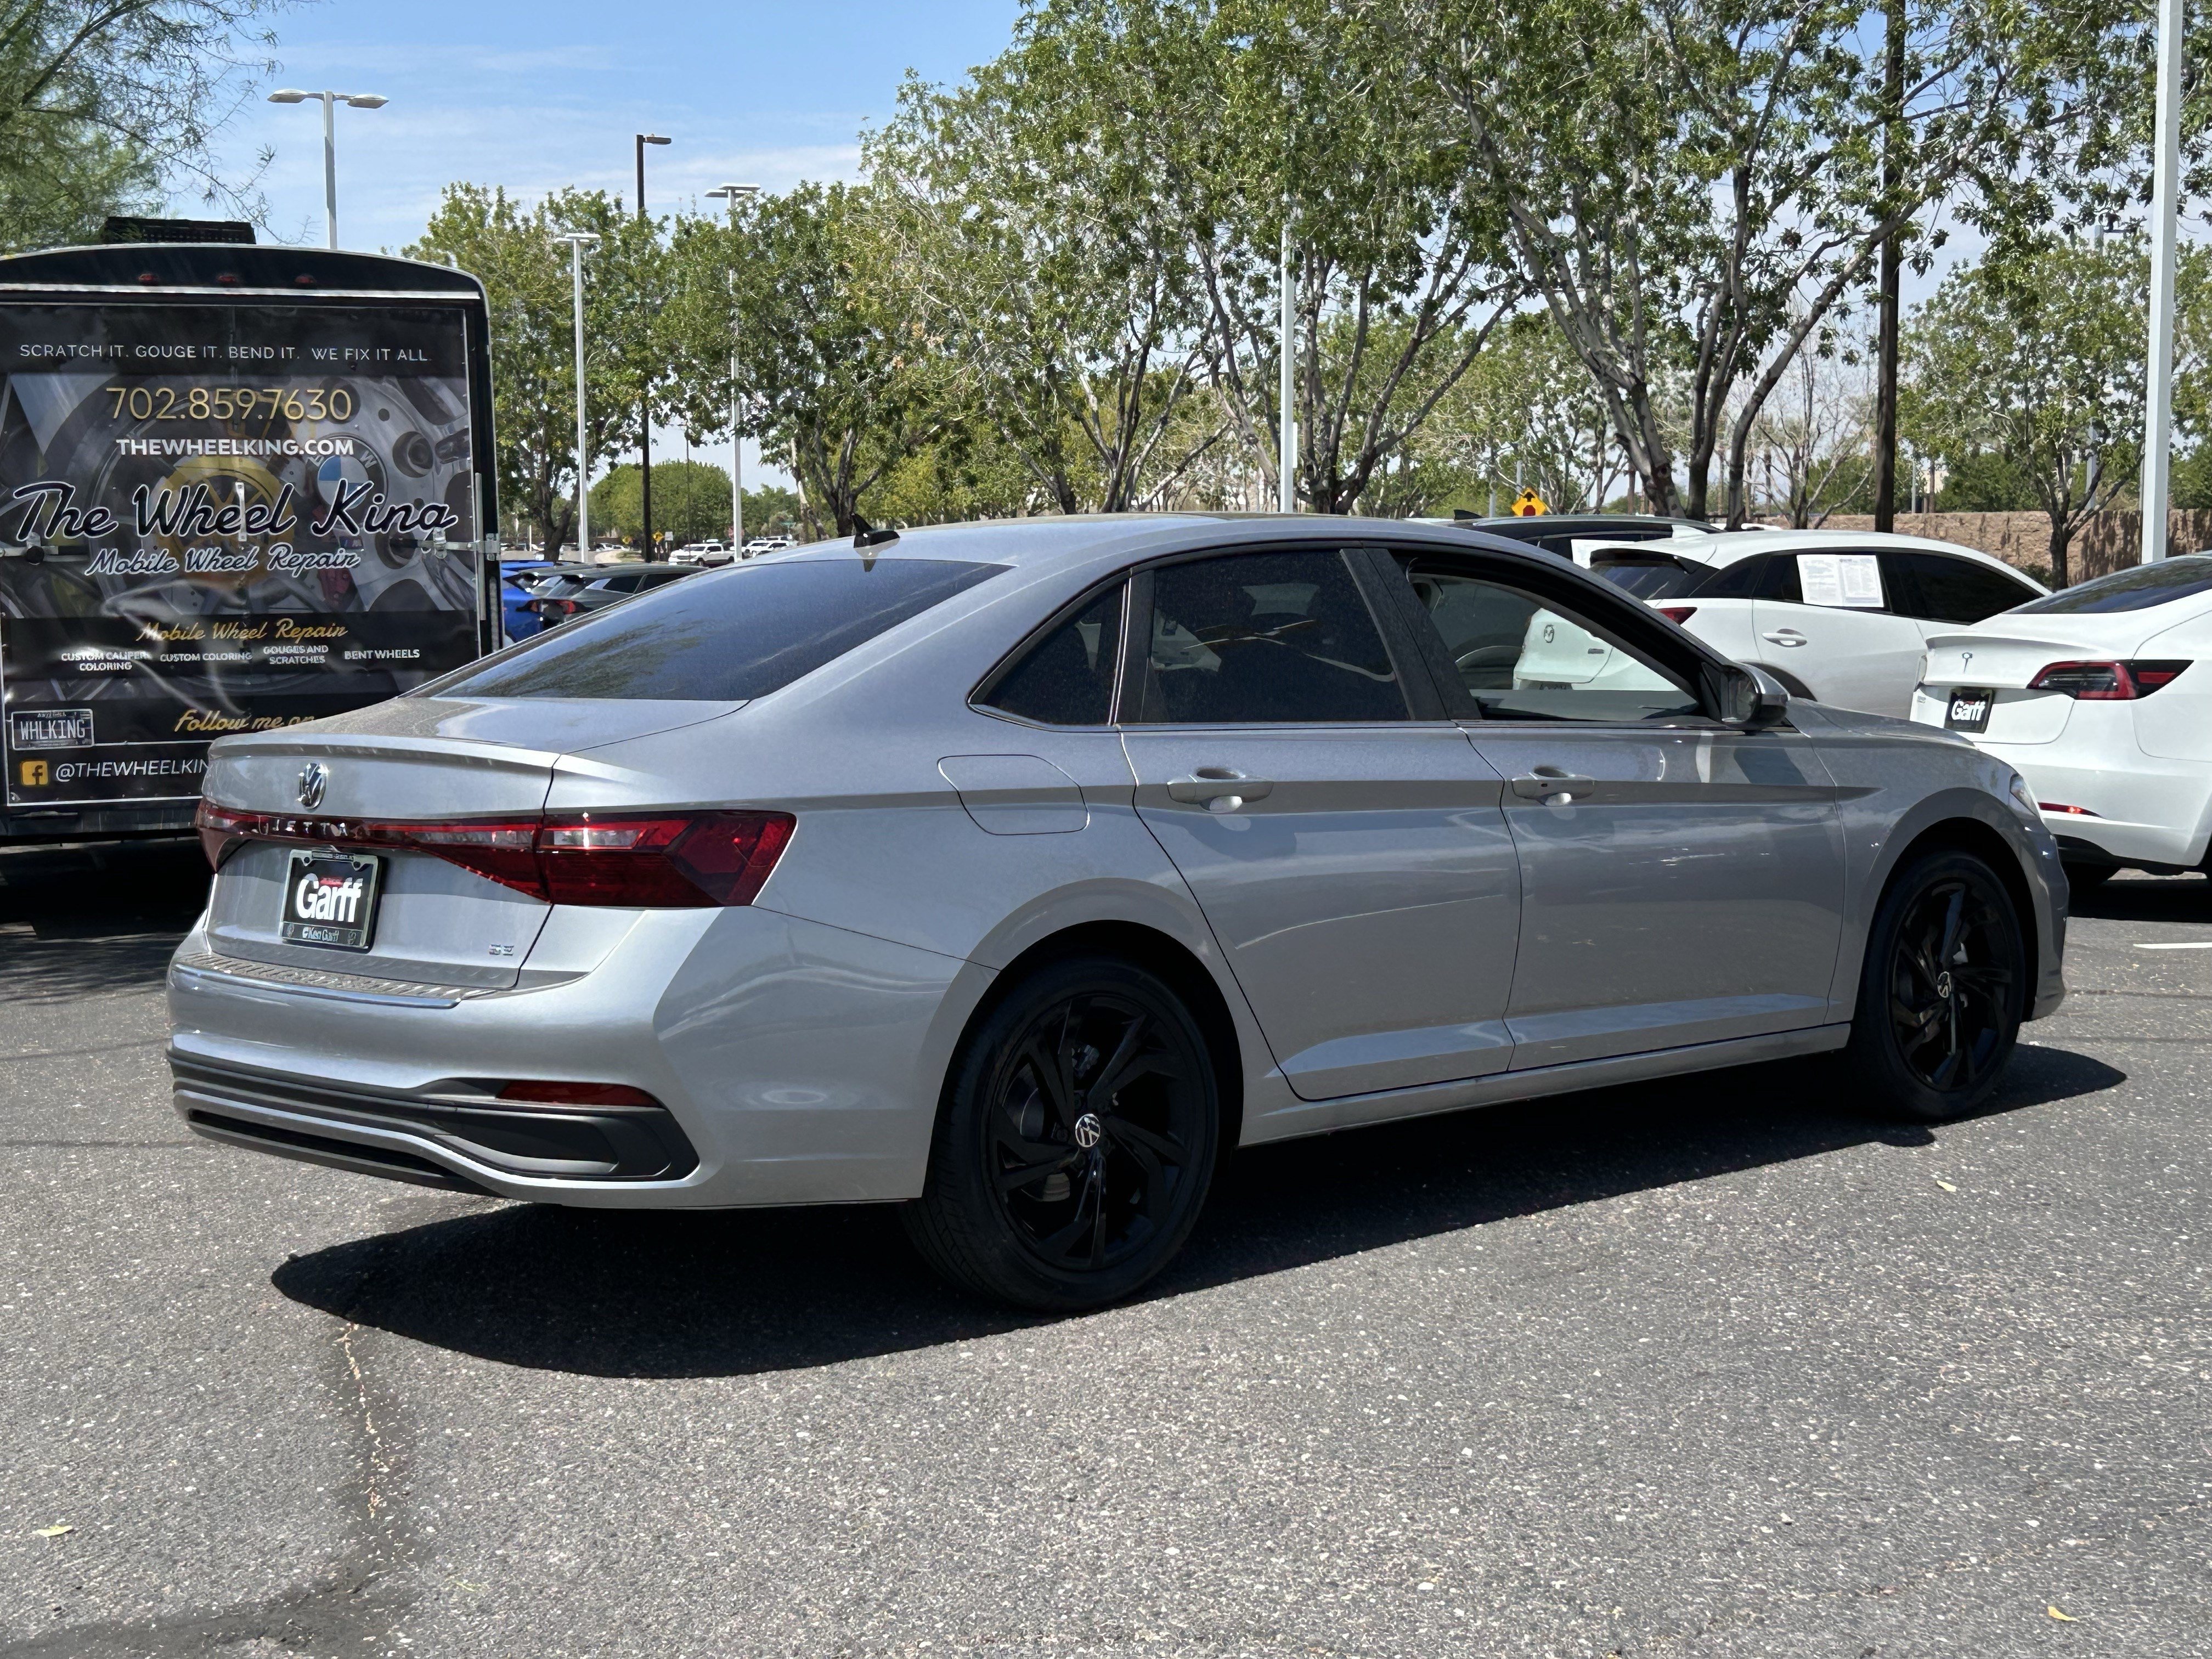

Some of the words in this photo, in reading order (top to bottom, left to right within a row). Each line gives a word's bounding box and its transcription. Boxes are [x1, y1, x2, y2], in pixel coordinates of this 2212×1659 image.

[20, 344, 102, 358] SCRATCH
[109, 345, 129, 358] IT.
[135, 345, 197, 358] GOUGE
[202, 346, 223, 359] IT.
[229, 346, 274, 359] BEND
[280, 346, 300, 359] IT.
[311, 347, 338, 360] WE
[344, 347, 370, 361] FIX
[376, 348, 391, 361] IT
[106, 387, 352, 421] 702.859.7630
[116, 438, 354, 456] THEWHEELKING.COM
[13, 481, 119, 542] The
[132, 482, 297, 538] Wheel
[84, 547, 180, 576] Mobile
[184, 546, 260, 572] Wheel
[267, 541, 362, 578] Repair
[135, 622, 207, 642] Mobile
[212, 621, 268, 640] Wheel
[275, 618, 349, 644] Repair
[61, 651, 104, 662] CUSTOM
[105, 650, 153, 661] CALIPER
[160, 653, 200, 662] CUSTOM
[202, 651, 253, 662] COLORING
[263, 645, 306, 654] GOUGES
[306, 644, 329, 654] AND
[344, 650, 373, 660] BENT
[374, 648, 421, 659] WHEELS
[79, 662, 133, 672] COLORING
[269, 655, 326, 665] SCRATCHES
[1951, 698, 1985, 721] Garff
[20, 719, 86, 740] WHLKING
[174, 709, 249, 732] Follow
[251, 716, 285, 730] me
[272, 819, 348, 837] JETTA
[296, 872, 364, 923] Garff
